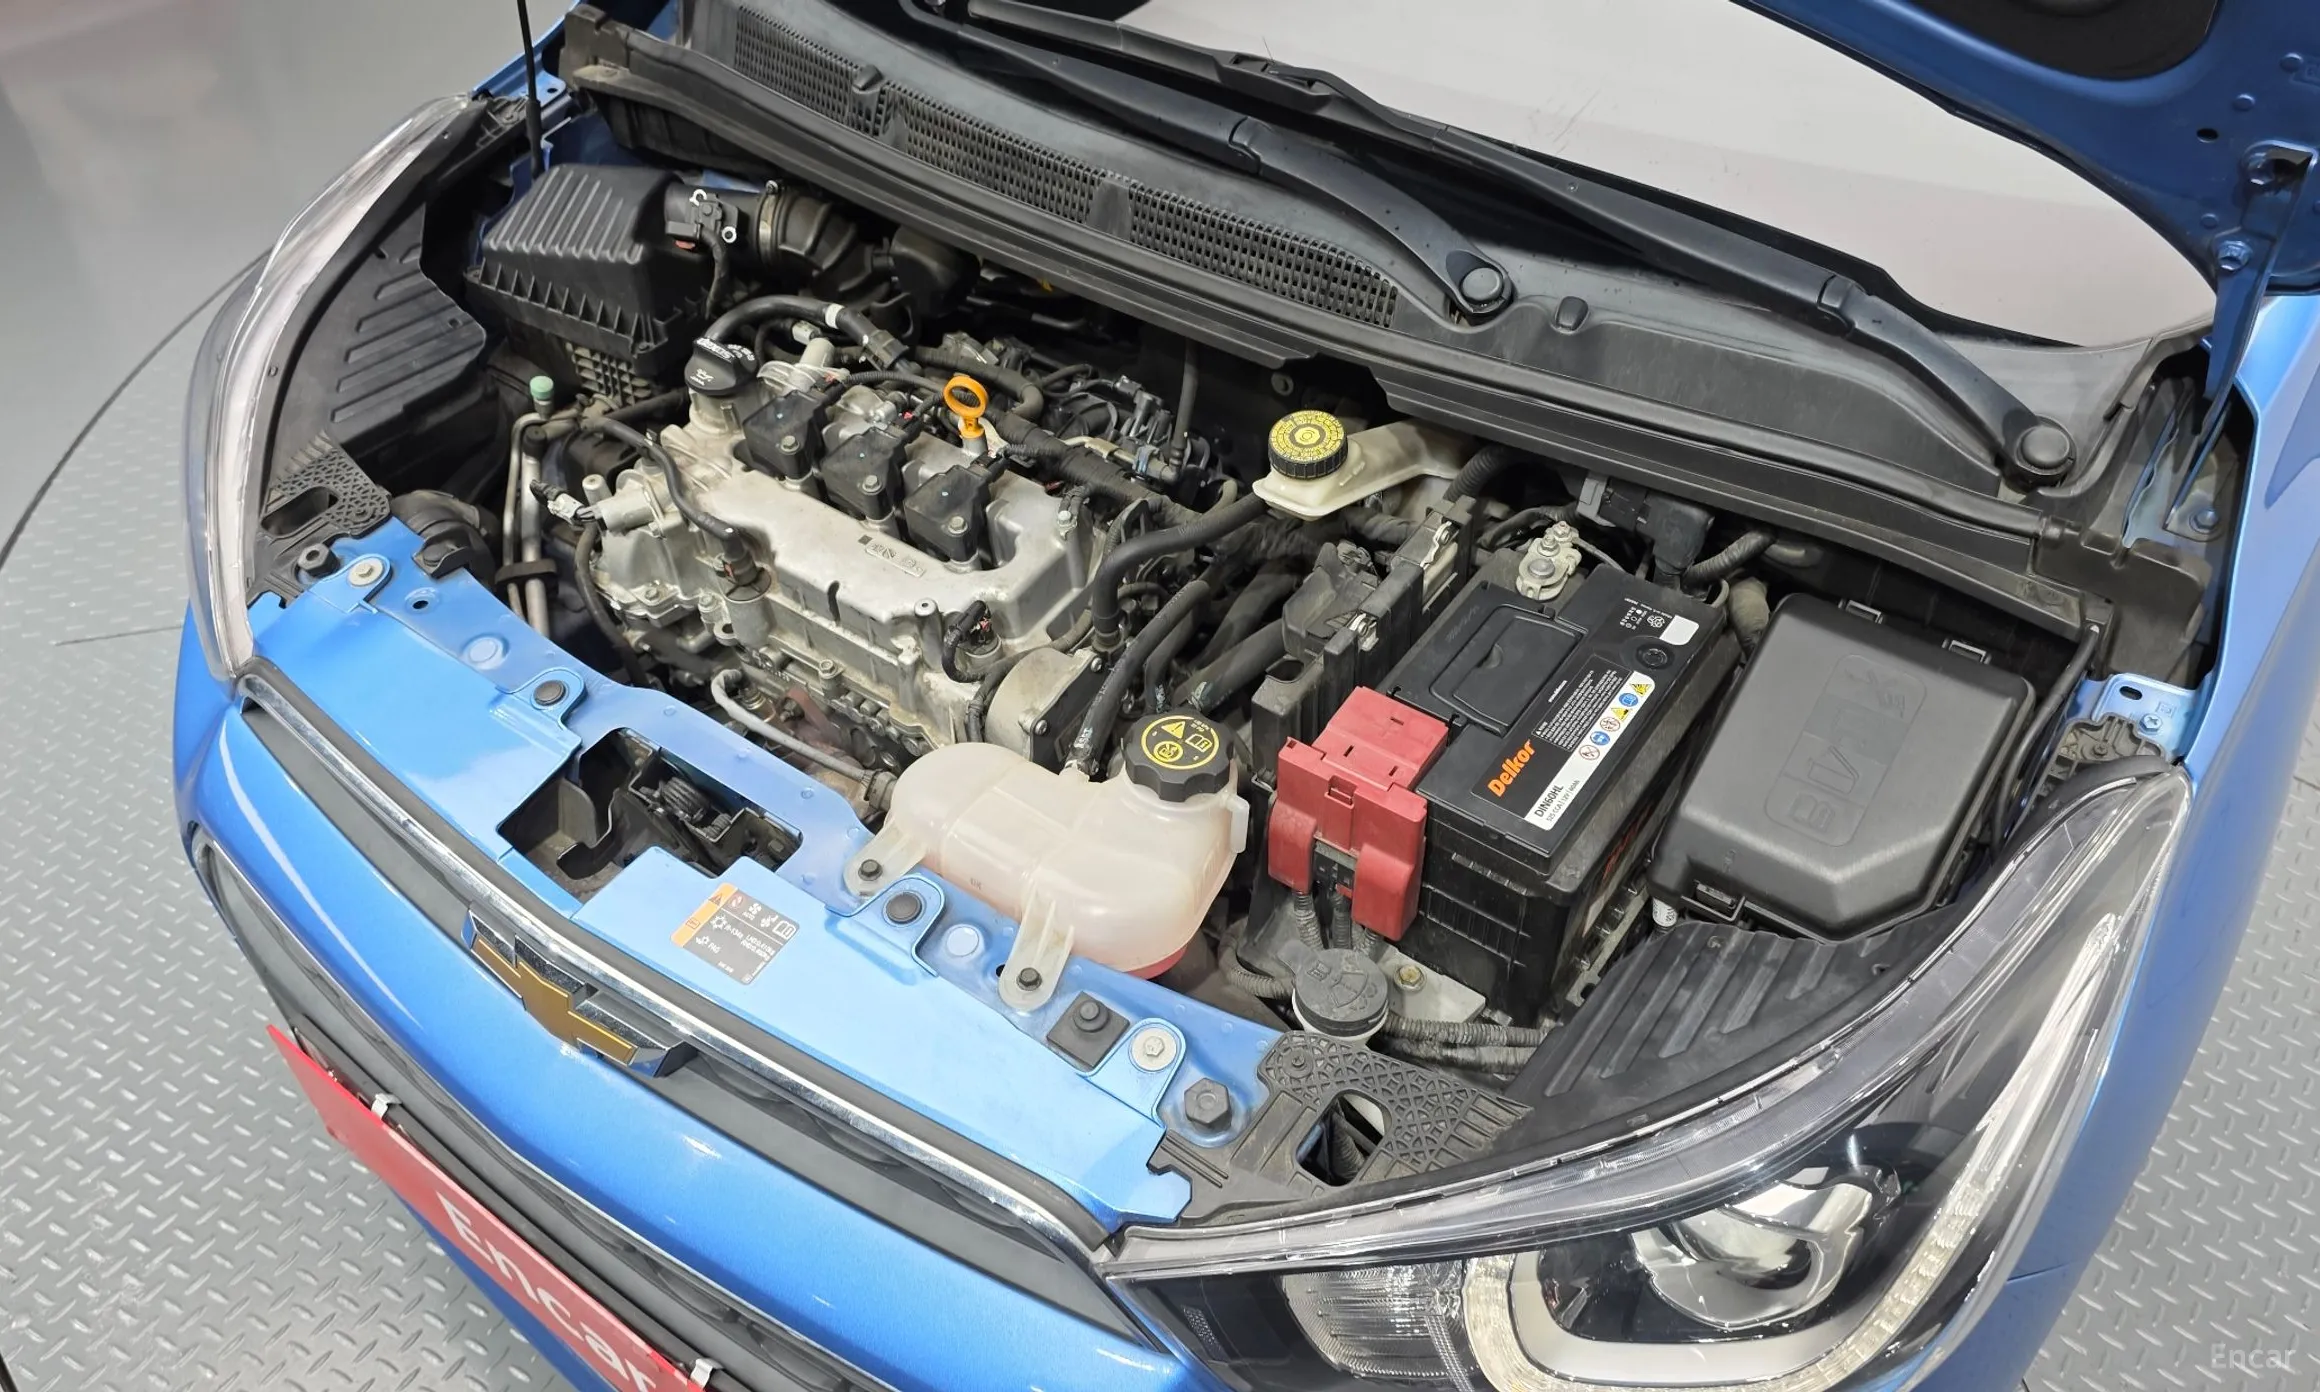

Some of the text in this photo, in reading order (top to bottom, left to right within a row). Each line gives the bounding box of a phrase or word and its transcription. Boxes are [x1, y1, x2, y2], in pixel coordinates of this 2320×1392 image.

[1487, 739, 1535, 797] Delkor
[1534, 785, 1564, 817] DIN60HL
[436, 1191, 656, 1392] Encar
